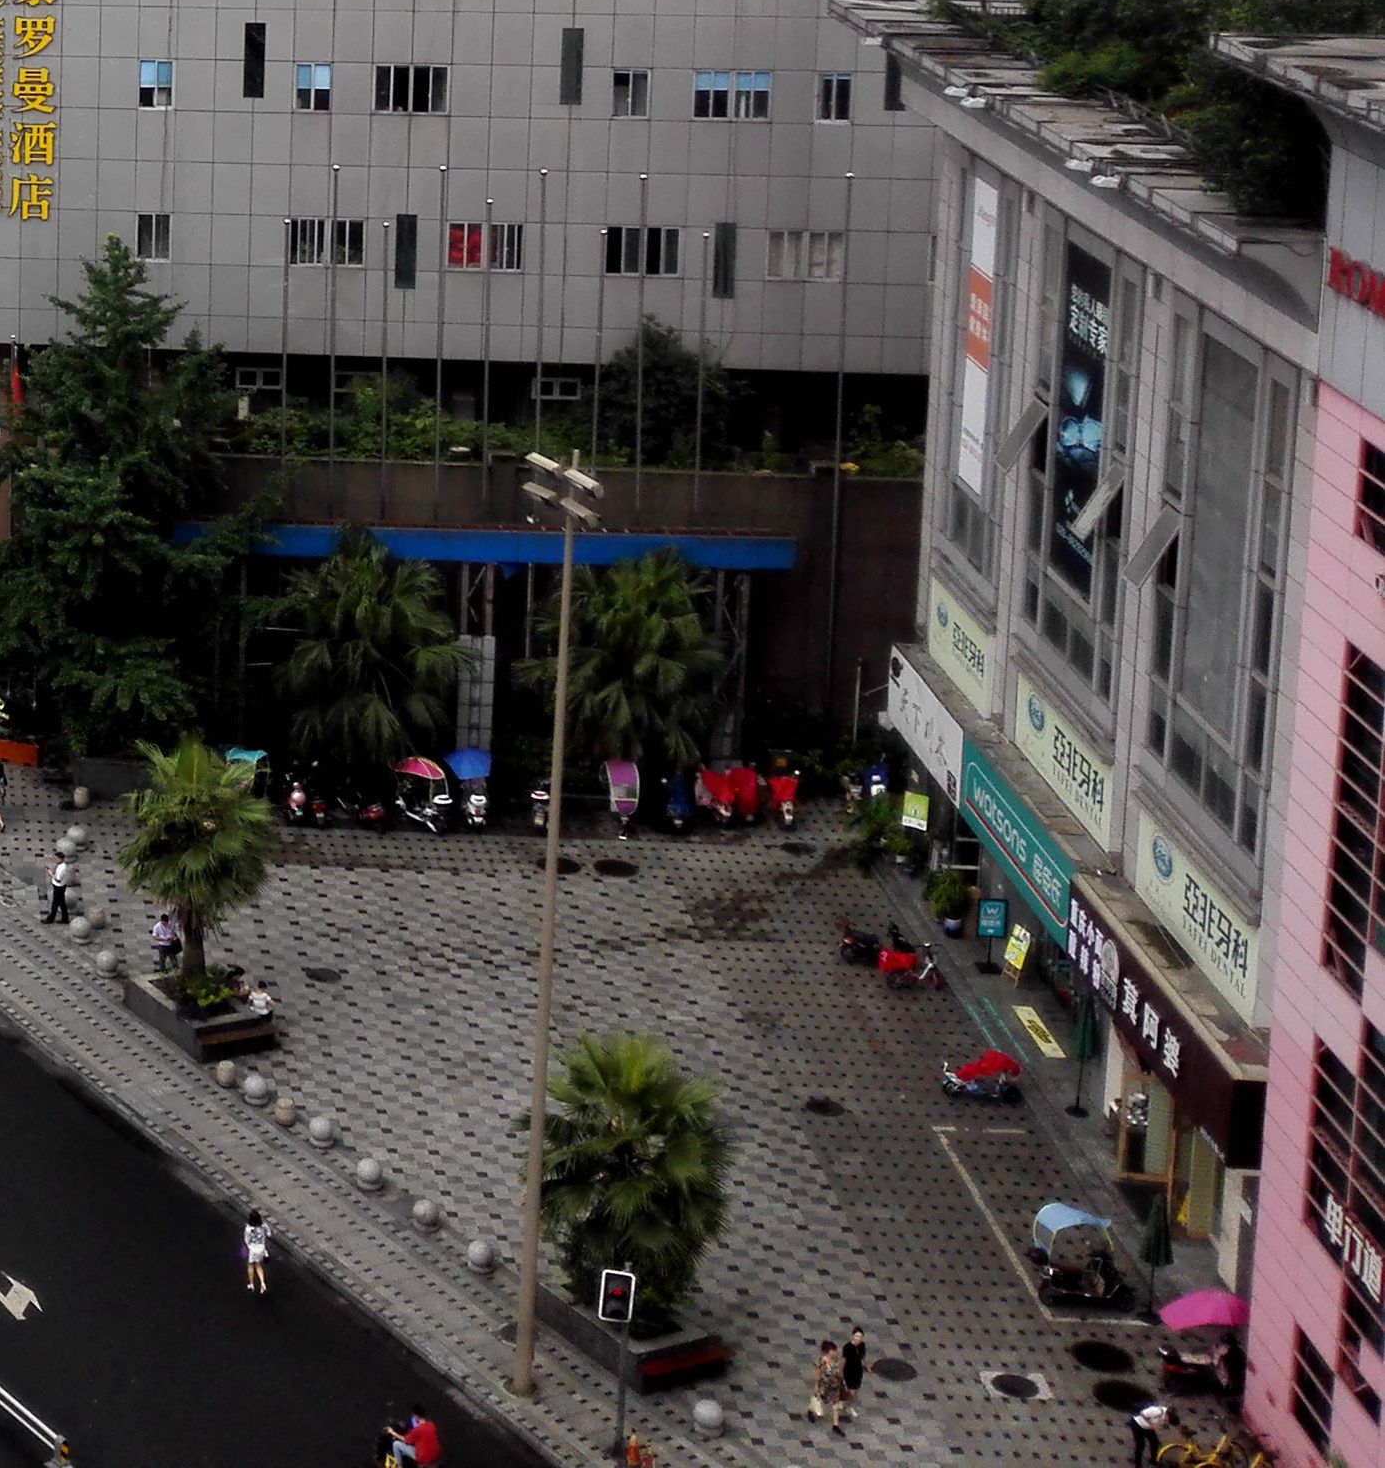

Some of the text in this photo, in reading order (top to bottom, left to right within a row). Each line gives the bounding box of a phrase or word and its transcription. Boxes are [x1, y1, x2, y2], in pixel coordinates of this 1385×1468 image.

[973, 777, 1027, 864] watsons
[1182, 918, 1246, 999] YAFEI DENTAL
